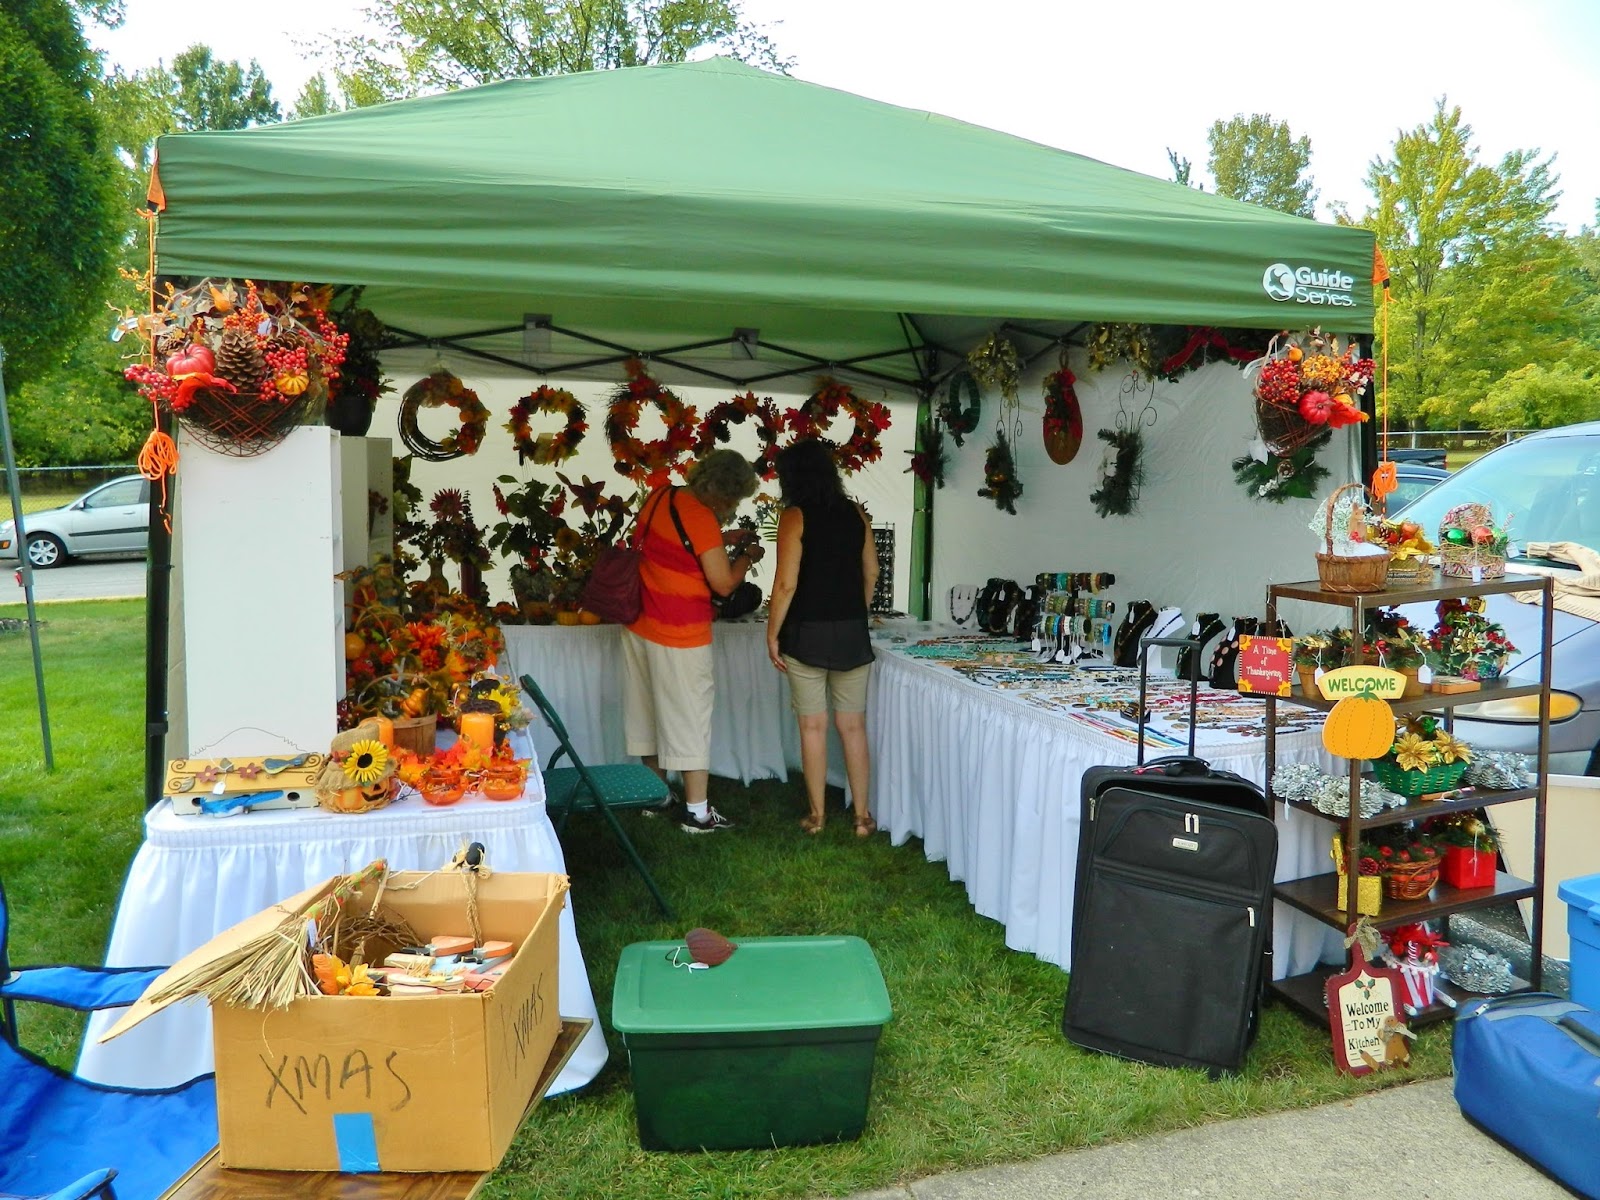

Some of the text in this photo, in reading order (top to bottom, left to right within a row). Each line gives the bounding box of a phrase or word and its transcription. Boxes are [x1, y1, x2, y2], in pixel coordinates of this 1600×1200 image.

[1295, 266, 1353, 287] Guide
[1252, 645, 1277, 655] A Time
[1260, 656, 1268, 666] of
[1246, 665, 1282, 681] Thanksgiving
[1328, 677, 1396, 693] WELCOME
[1346, 1002, 1389, 1017] Welcome
[1352, 1016, 1381, 1031] To My
[1348, 1036, 1380, 1051] Kitchen
[258, 1048, 412, 1116] XMAS
